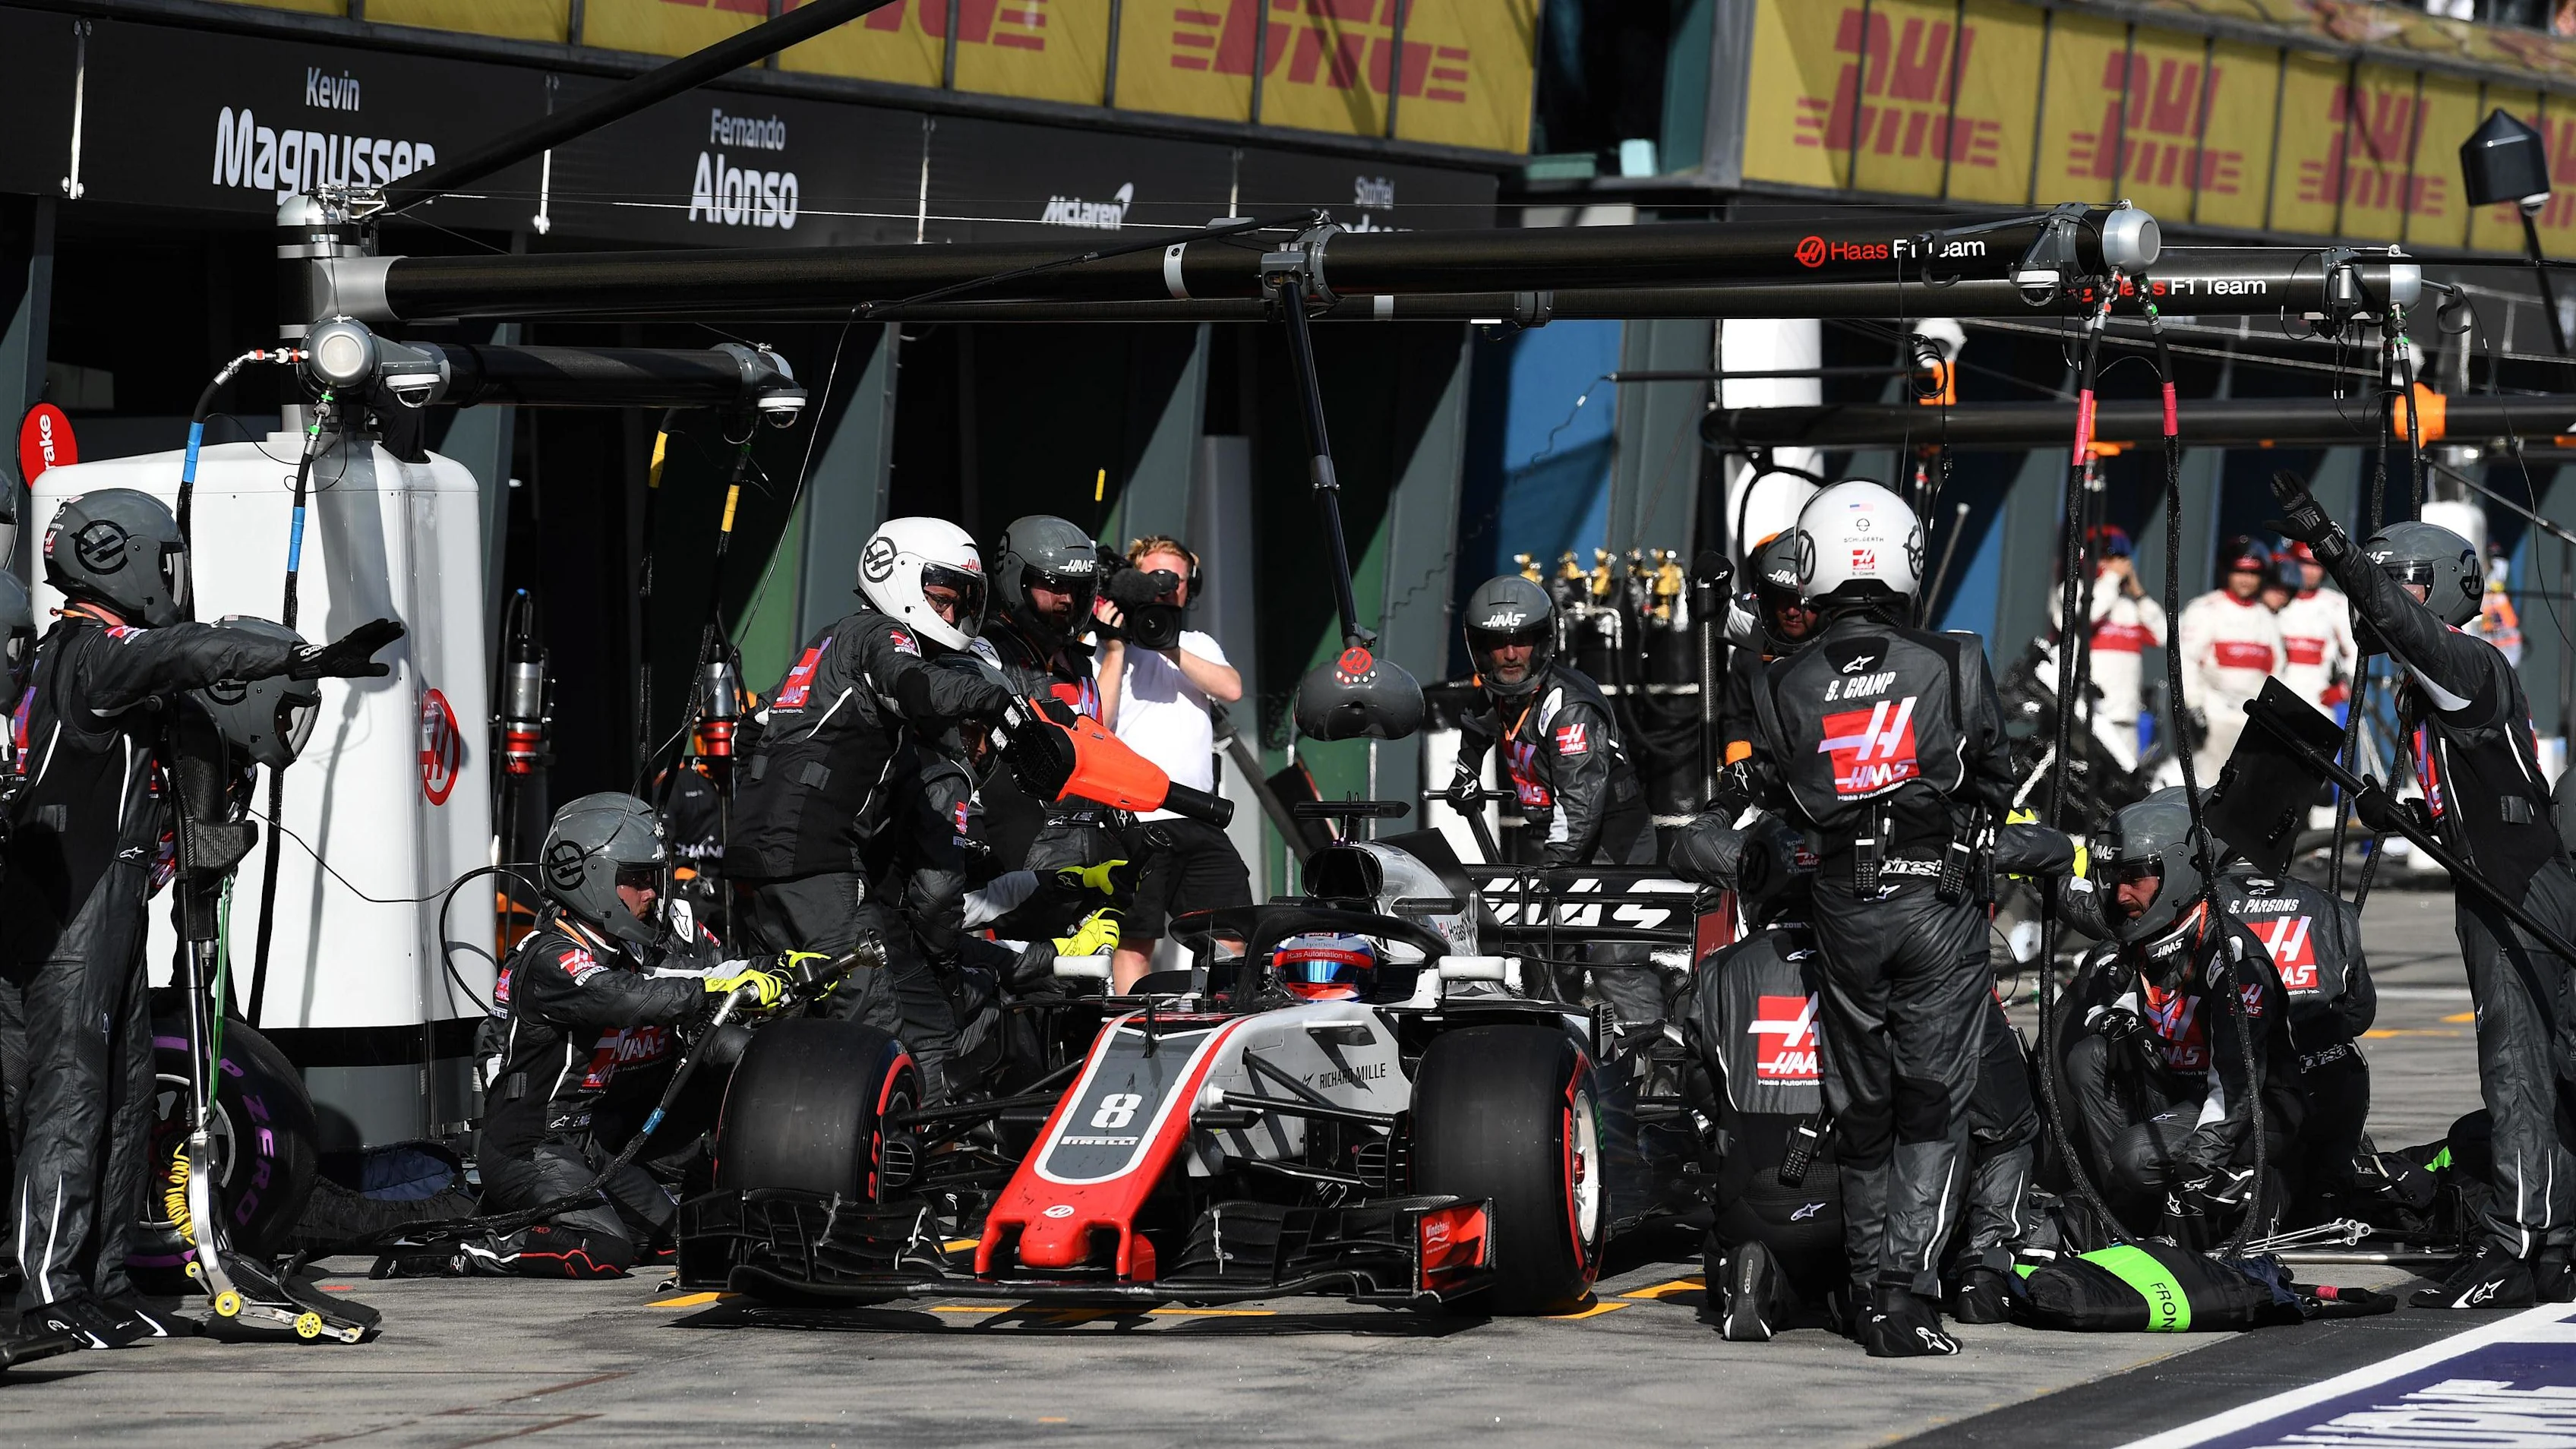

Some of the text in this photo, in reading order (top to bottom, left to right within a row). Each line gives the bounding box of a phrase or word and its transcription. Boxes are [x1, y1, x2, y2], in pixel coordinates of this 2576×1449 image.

[305, 67, 360, 112] Kevin
[1824, 8, 1976, 163] DHL
[711, 109, 786, 152] Fernando
[2093, 49, 2221, 191] DHL
[2320, 84, 2430, 213] DHL
[689, 152, 799, 229] Alonso
[1041, 194, 1123, 230] McLaren
[1830, 242, 1889, 260] Haas
[2171, 278, 2196, 295] F1
[2199, 278, 2266, 295] Team
[39, 414, 55, 471] rake
[961, 558, 982, 571] HAA
[1058, 560, 1095, 573] HAAS
[2366, 551, 2394, 565] AS
[1767, 569, 1798, 586] HAA
[1482, 612, 1526, 627] HAAS
[1824, 671, 1897, 702] S. CRAMP
[1835, 759, 1918, 789] HAAS
[2228, 898, 2300, 914] S. PARSONS
[1303, 950, 1343, 959] Automation
[2152, 937, 2185, 958] HAAS
[2280, 964, 2318, 986] AS
[1757, 1051, 1824, 1075] HAA
[1320, 1063, 1386, 1089] RICHARD MILLE
[1091, 1094, 1143, 1129] 8
[1060, 1136, 1139, 1145] PIRELLI
[2150, 1282, 2177, 1333] FRON
